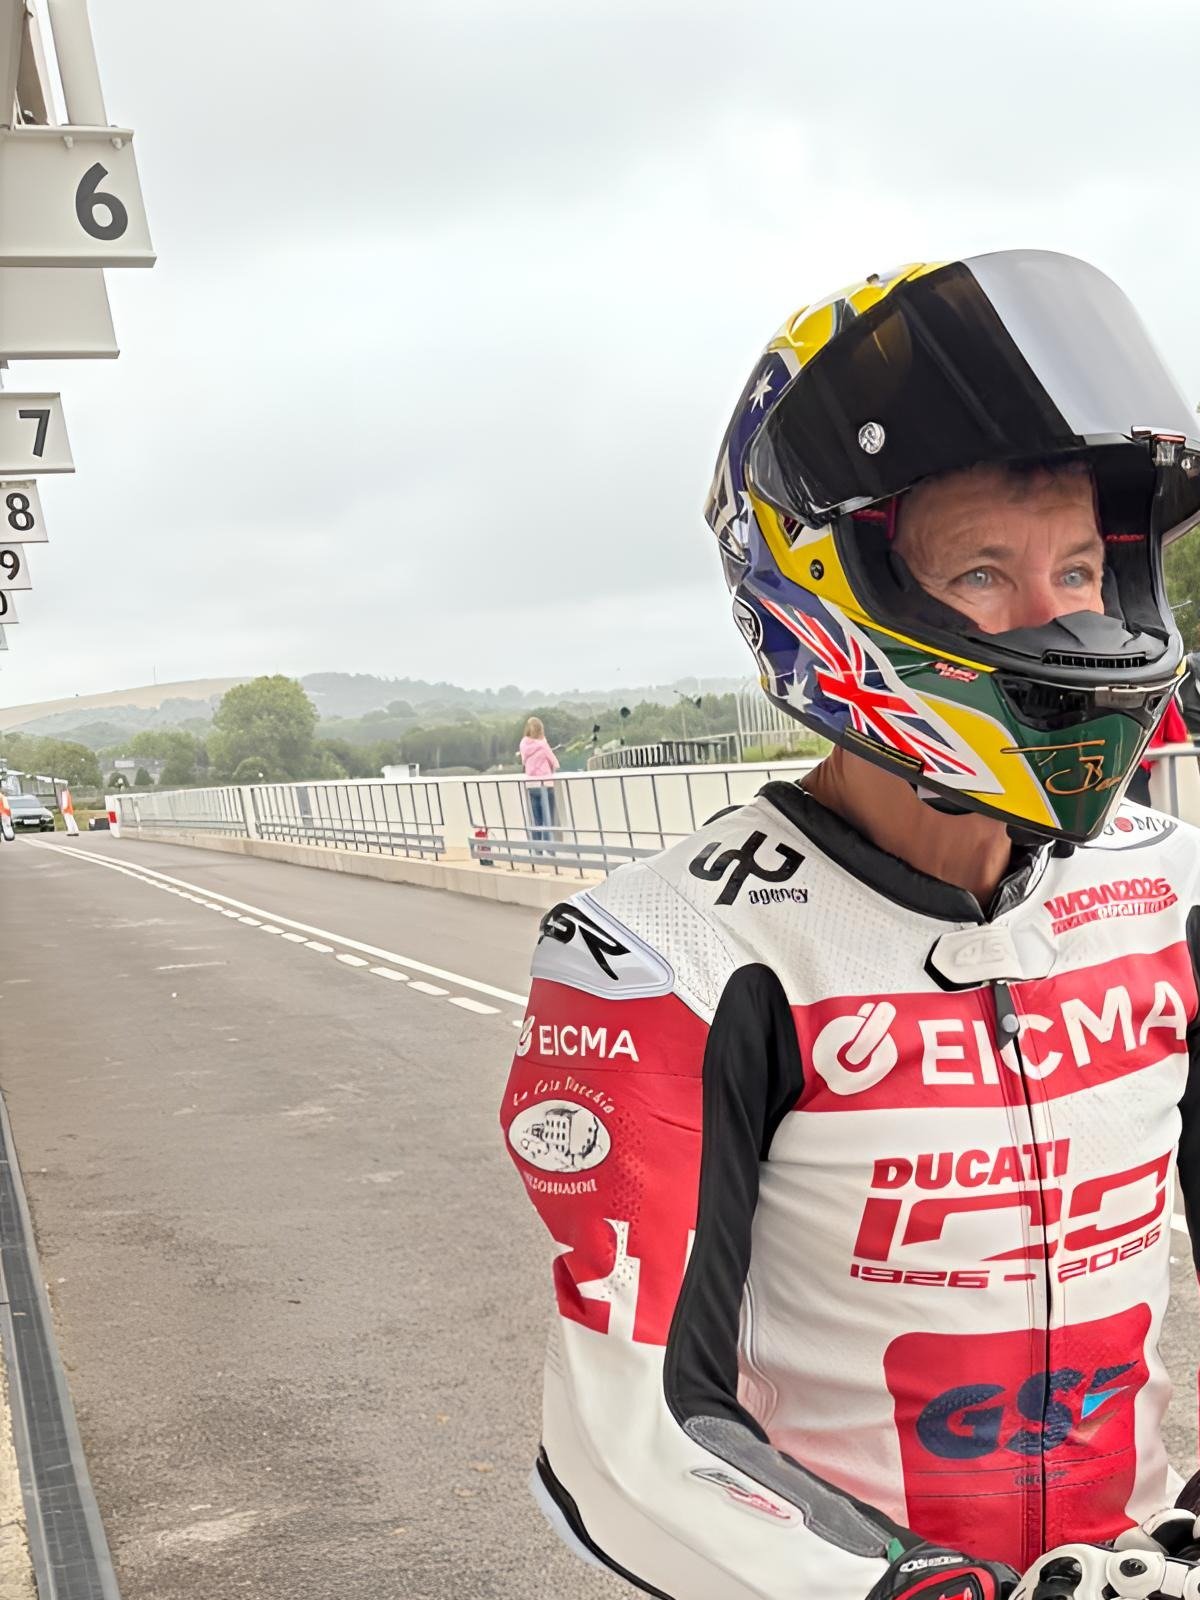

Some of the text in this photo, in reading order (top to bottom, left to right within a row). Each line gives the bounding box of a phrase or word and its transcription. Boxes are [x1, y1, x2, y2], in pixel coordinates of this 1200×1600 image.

[75, 162, 128, 241] 6
[18, 409, 51, 458] 7
[5, 492, 35, 531] 8
[0, 550, 20, 581] 9
[538, 1024, 640, 1063] EICMA
[917, 980, 1188, 1086] EICMA
[870, 1138, 1071, 1190] DUCATI
[850, 1263, 991, 1289] 1926
[1057, 1223, 1162, 1284] 2026
